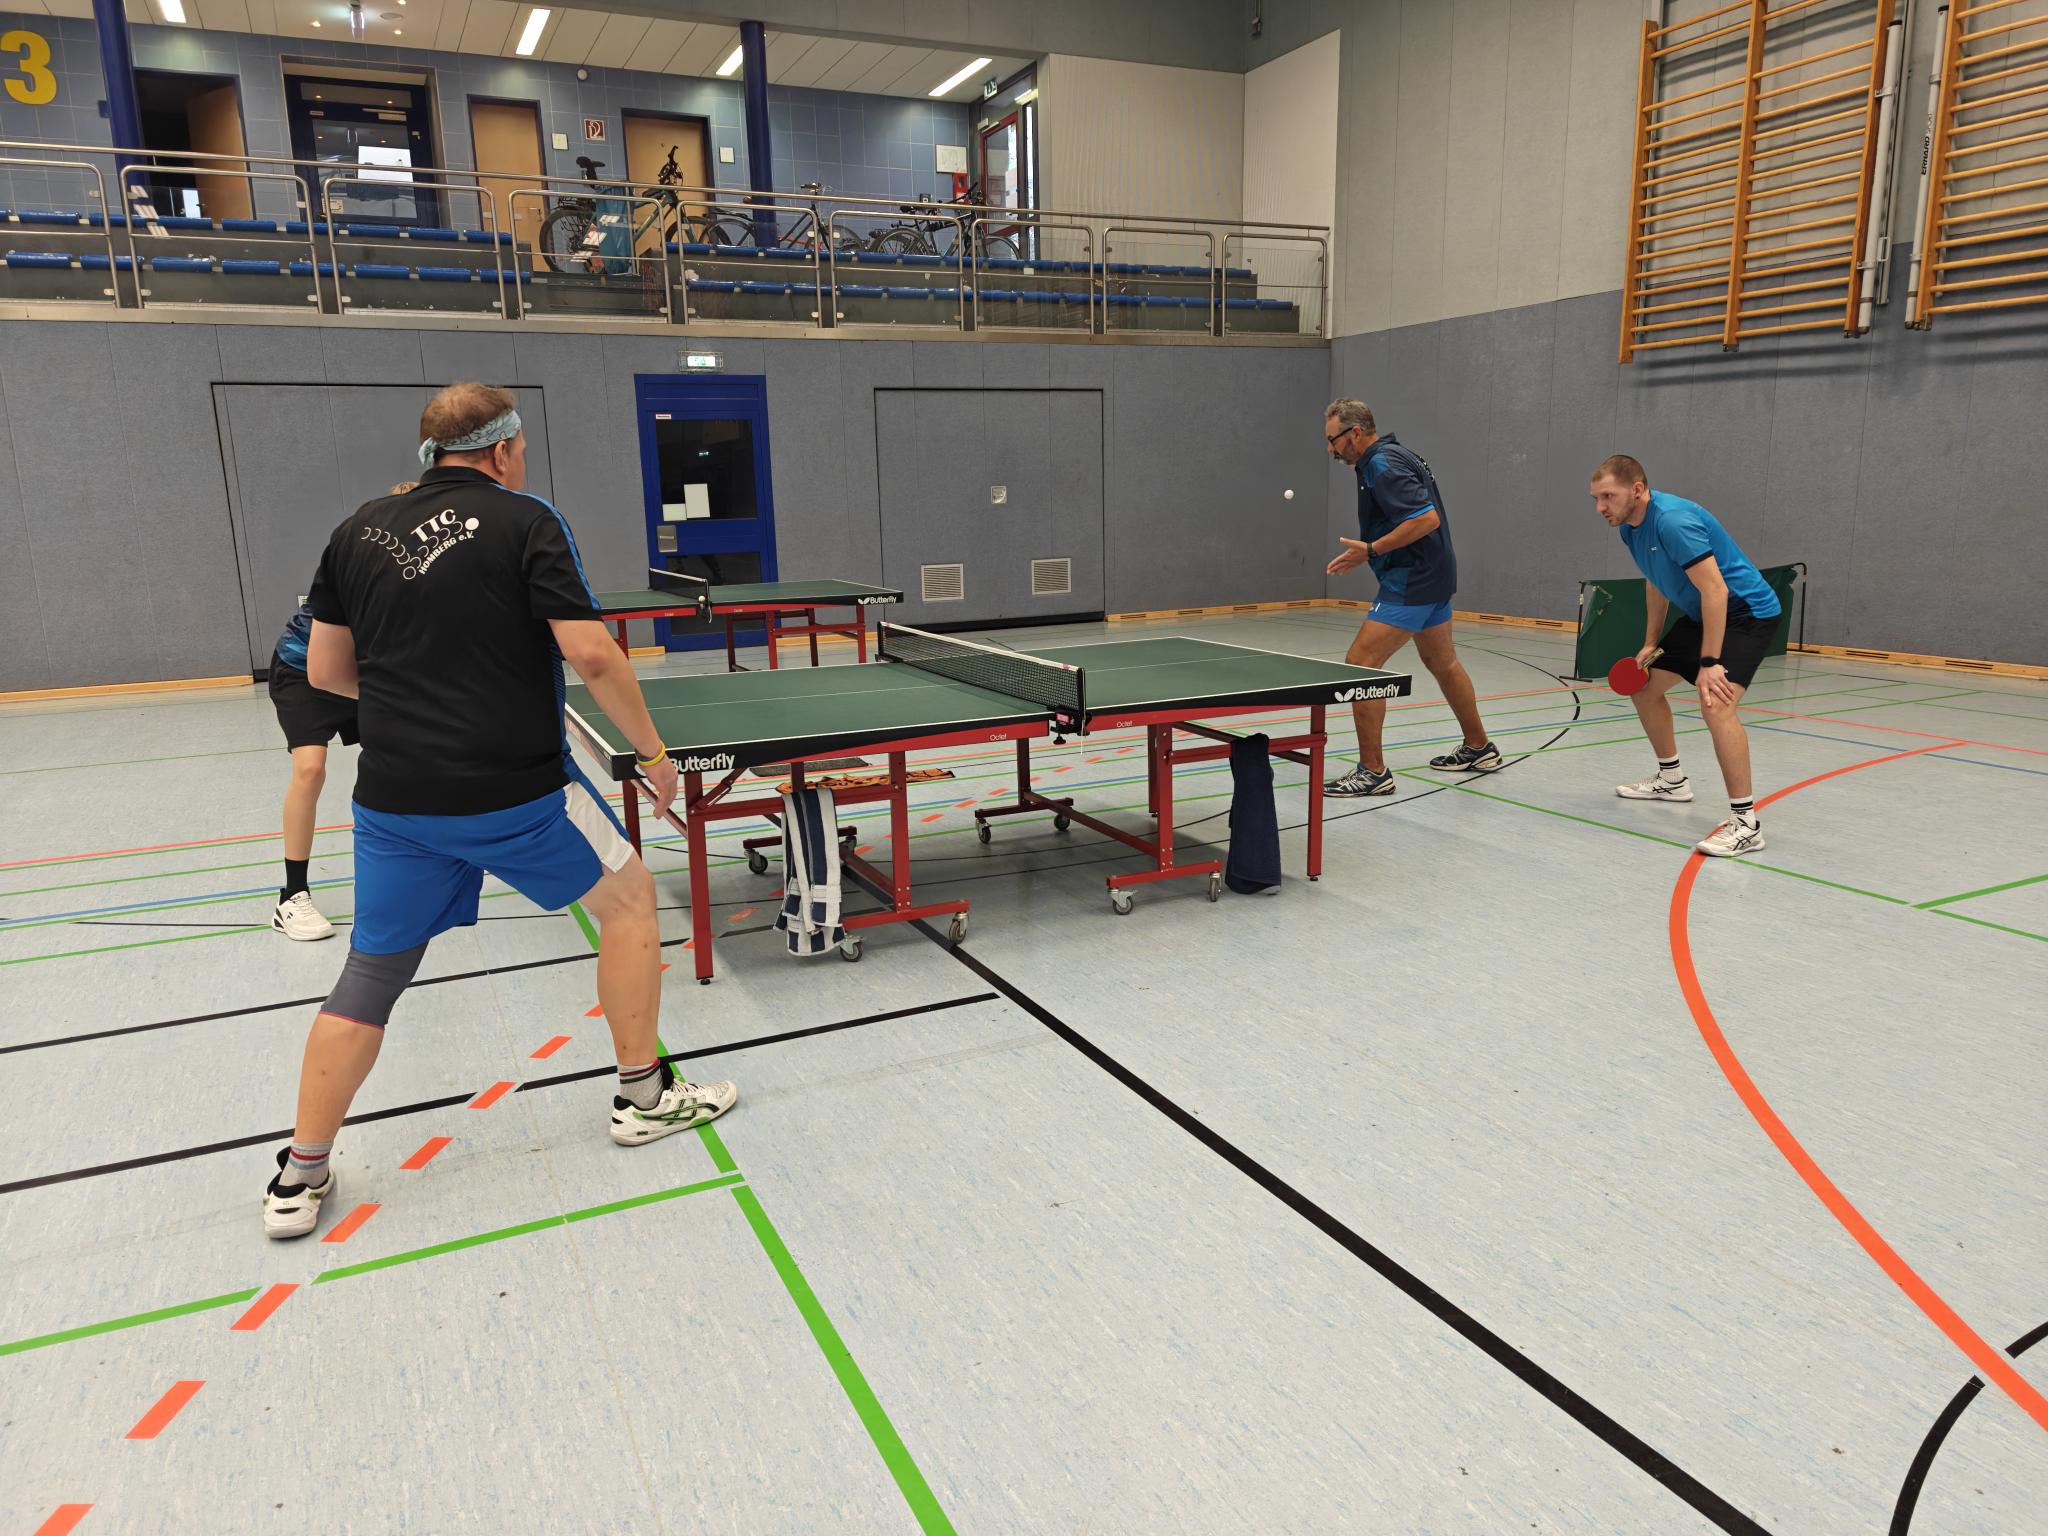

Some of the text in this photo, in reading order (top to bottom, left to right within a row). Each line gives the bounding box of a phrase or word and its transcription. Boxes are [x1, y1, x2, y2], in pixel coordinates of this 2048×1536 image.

[0, 30, 57, 105] 3
[1921, 136, 1930, 175] ERHARD
[410, 509, 456, 543] TTC
[419, 537, 457, 575] HOMBERG
[870, 595, 897, 604] Butterfly
[1355, 683, 1400, 700] Butterfly
